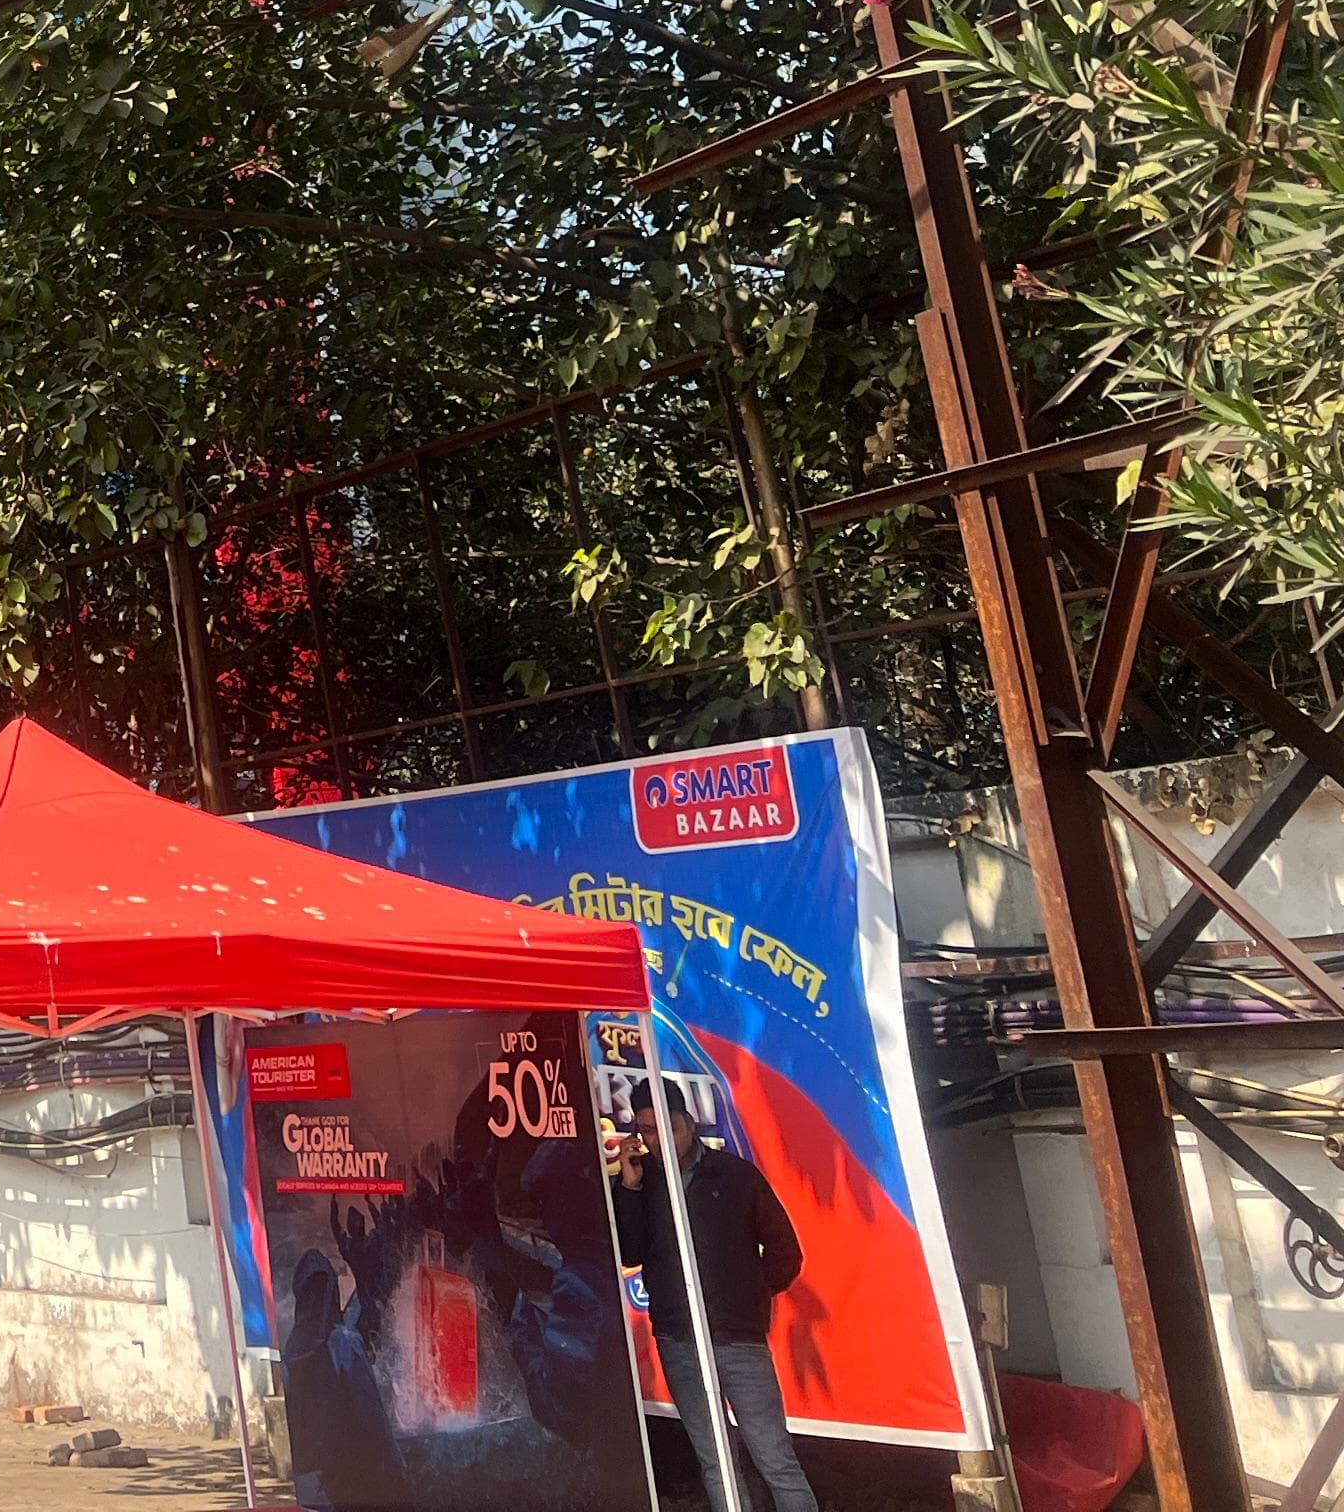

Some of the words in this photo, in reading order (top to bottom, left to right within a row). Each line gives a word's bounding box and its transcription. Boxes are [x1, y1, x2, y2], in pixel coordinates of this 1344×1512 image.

[673, 758, 773, 806] SMART
[675, 800, 783, 836] BAZAAR
[670, 894, 735, 949] হবে
[500, 1032, 516, 1054] UP
[516, 1030, 537, 1052] TO
[251, 1055, 316, 1071] AMERICAN
[251, 1069, 316, 1084] TOURISTER
[487, 1058, 568, 1138] 50%
[282, 1113, 354, 1153] GLOBAL
[551, 1109, 574, 1136] OFF
[296, 1151, 389, 1178] WARRANTY
